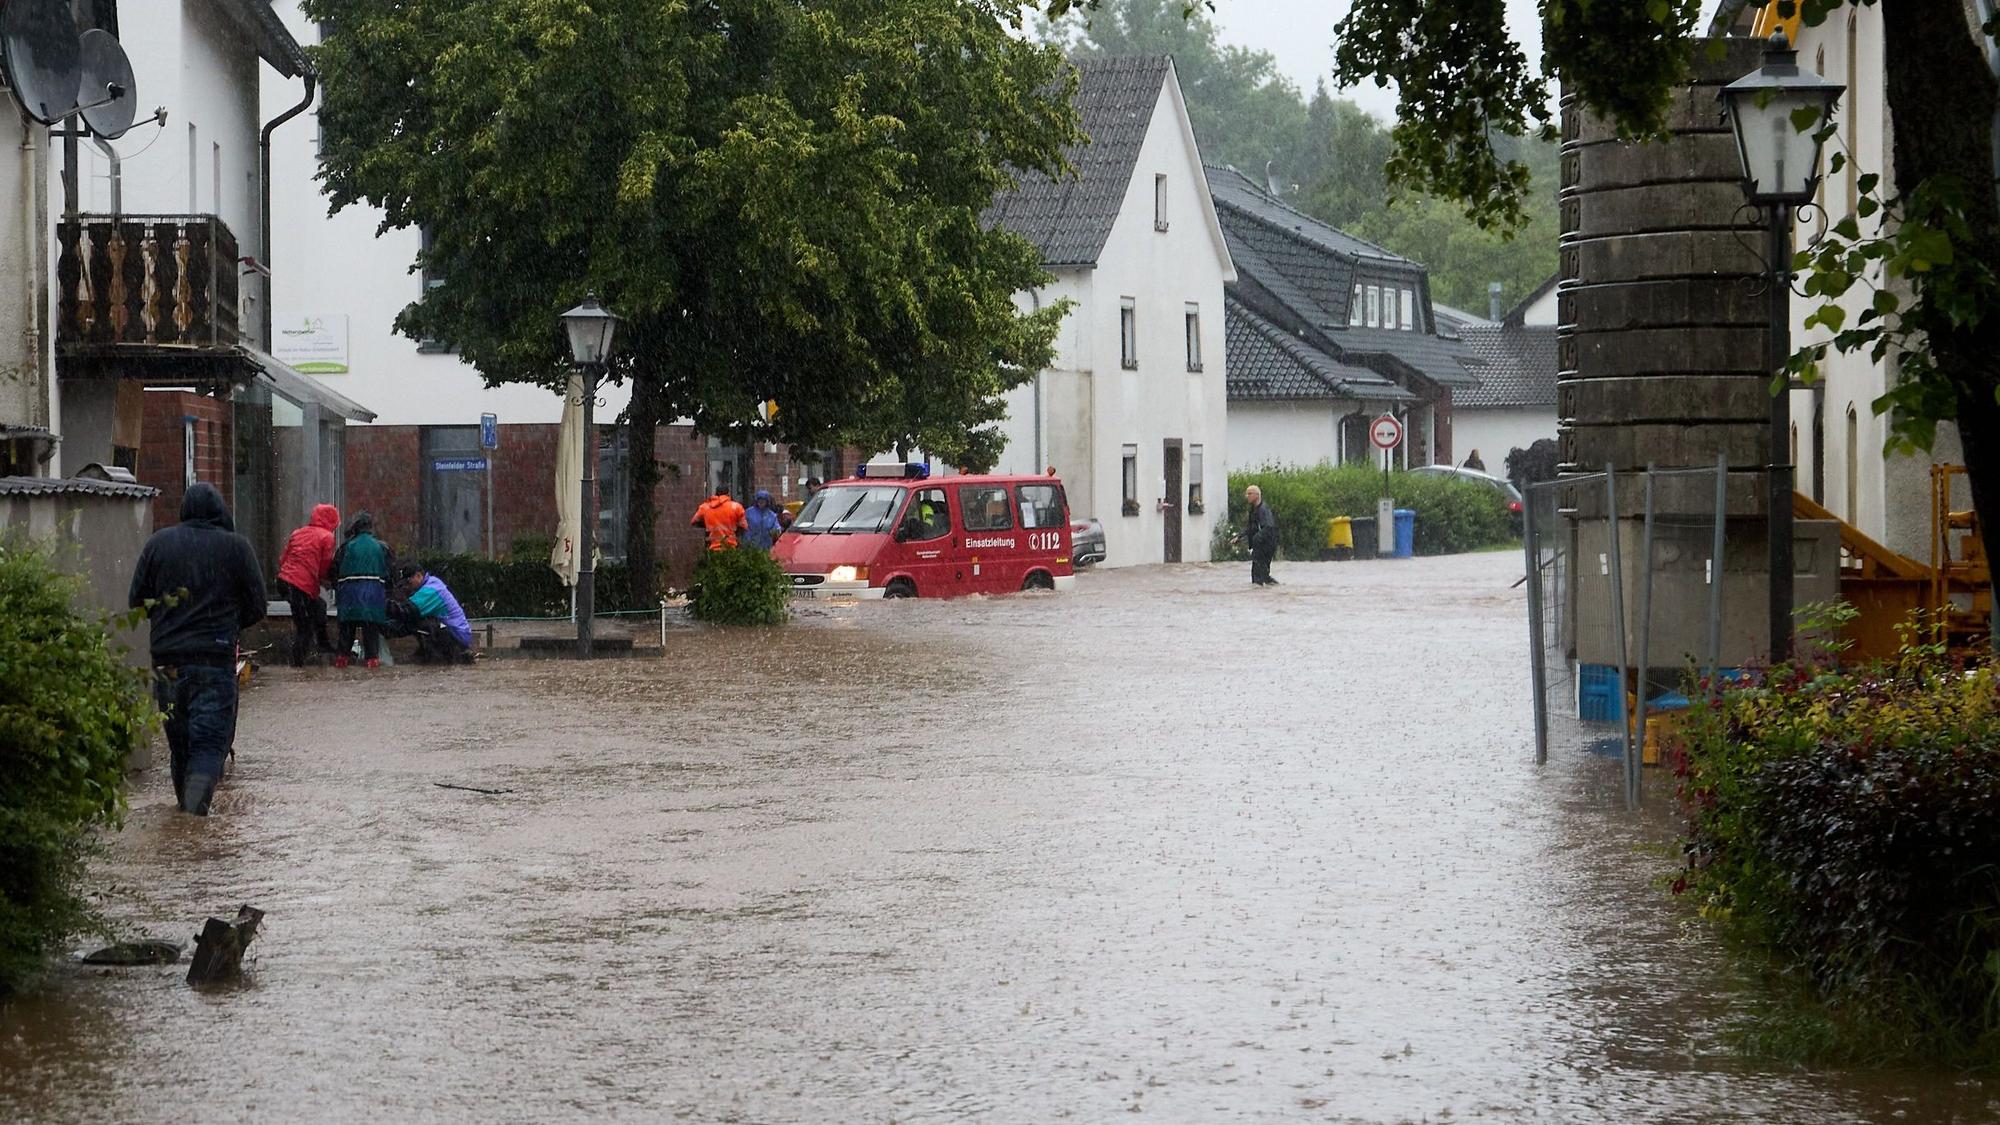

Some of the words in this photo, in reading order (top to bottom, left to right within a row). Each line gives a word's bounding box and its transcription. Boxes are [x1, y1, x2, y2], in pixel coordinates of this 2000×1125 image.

[435, 461, 465, 470] Steinfelder
[466, 460, 485, 470] Straße
[965, 537, 1015, 549] Einsatzleitung
[1040, 531, 1060, 550] 112
